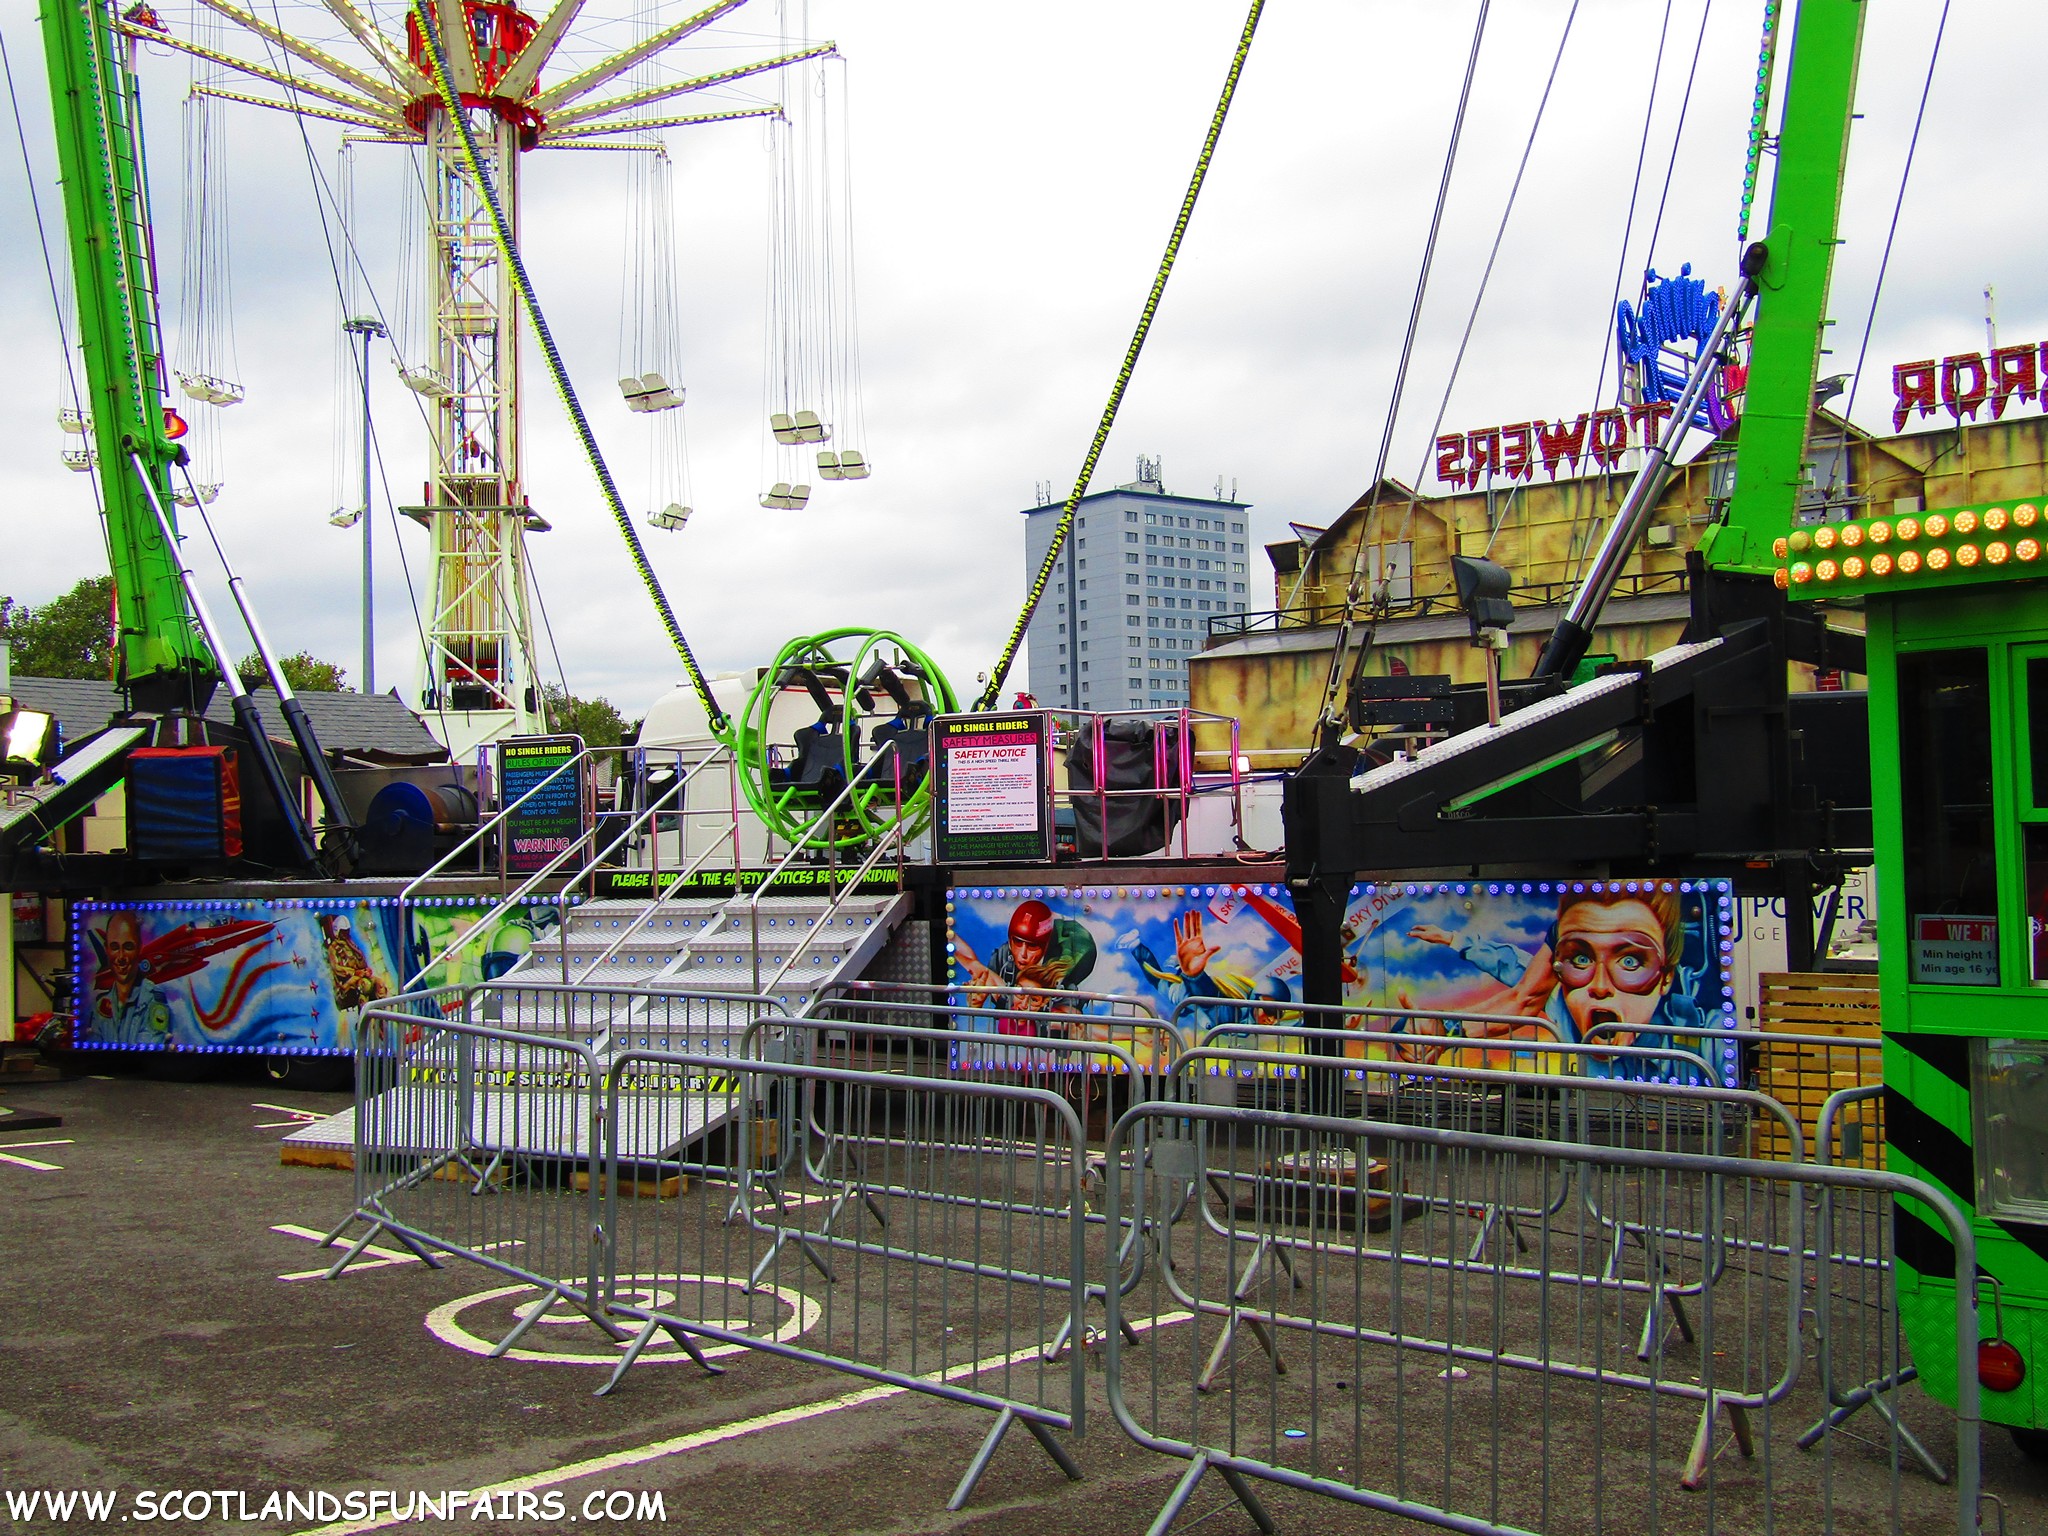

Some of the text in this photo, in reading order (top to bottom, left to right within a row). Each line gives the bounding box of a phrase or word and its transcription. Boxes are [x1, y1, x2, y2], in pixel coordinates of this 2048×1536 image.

[949, 720, 1029, 733] NO SINGLE RIDERS
[944, 734, 1036, 748] SAFETY MEASURES
[505, 745, 572, 756] NO SINGLE RIDERS
[954, 748, 1027, 759] SAFETY NOTICE
[507, 758, 530, 768] RULES
[533, 758, 543, 766] OF
[513, 837, 570, 852] WARNING
[611, 873, 649, 887] PLEASE
[651, 872, 680, 886] EAD
[681, 872, 698, 886] LL
[701, 872, 722, 886] THE
[816, 869, 857, 884] BEFOR
[1220, 895, 1239, 916] SKY
[1349, 905, 1371, 928] SKY
[1922, 949, 1943, 959] Min
[1946, 950, 1983, 961] height
[1274, 956, 1300, 978] DIVE
[1921, 963, 1941, 973] Min
[1944, 966, 1965, 976] age
[1969, 965, 1982, 974] 16
[440, 1069, 505, 1085] CATION
